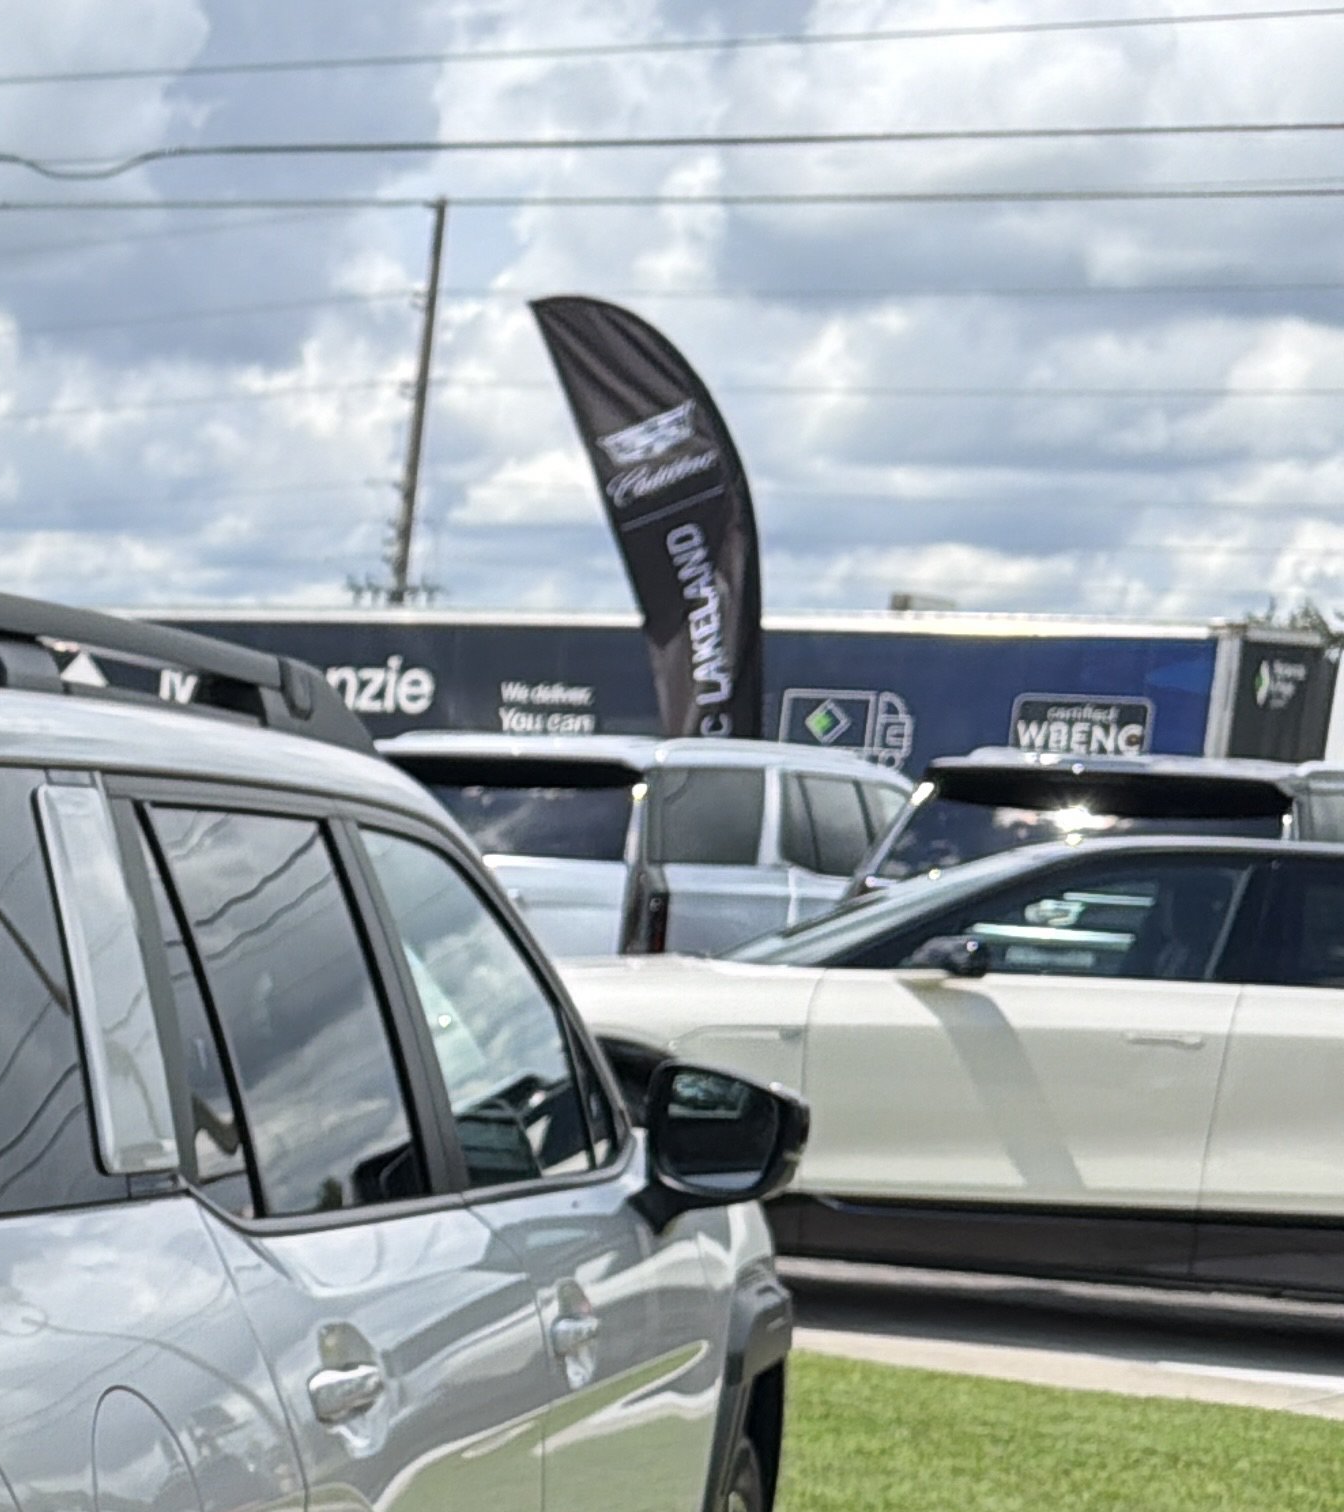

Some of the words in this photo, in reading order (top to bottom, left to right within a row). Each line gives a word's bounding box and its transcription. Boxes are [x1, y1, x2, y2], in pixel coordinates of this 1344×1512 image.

[666, 522, 733, 706] LAKELAND
[498, 706, 544, 733] You
[1017, 720, 1144, 755] WBENC
